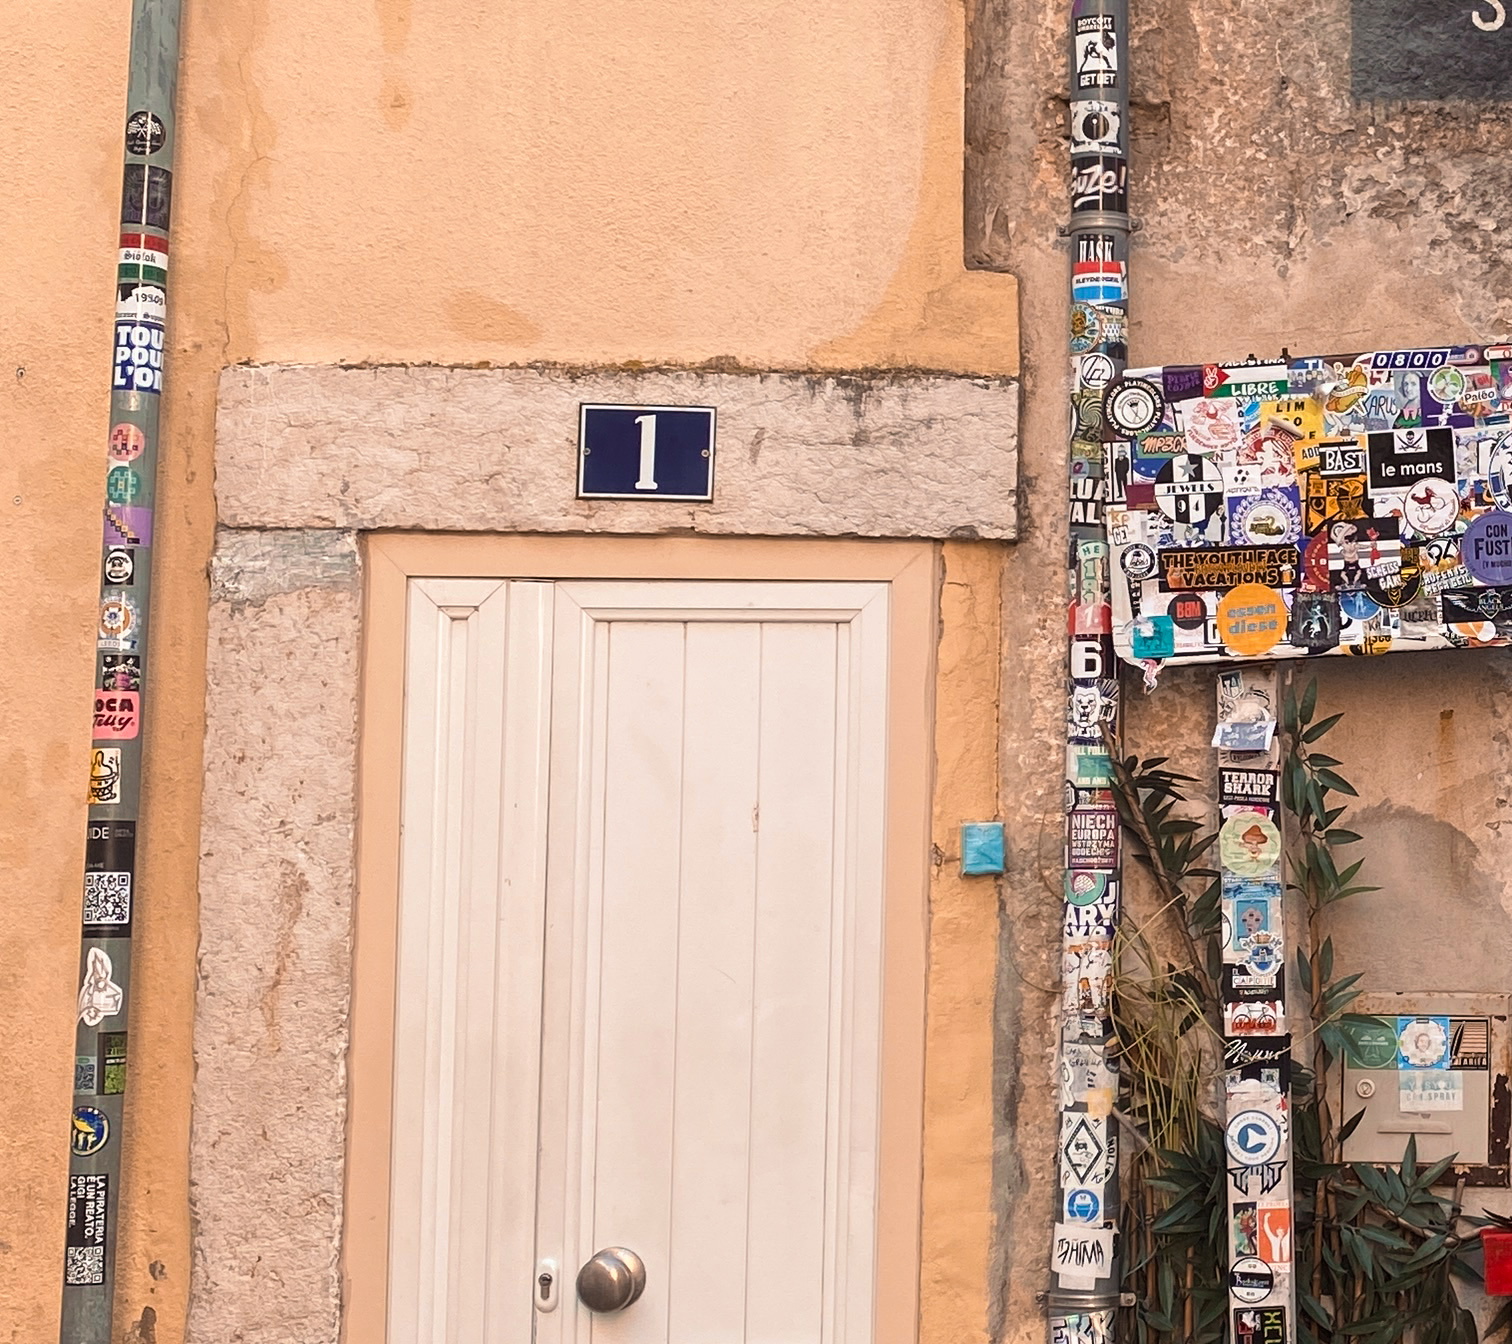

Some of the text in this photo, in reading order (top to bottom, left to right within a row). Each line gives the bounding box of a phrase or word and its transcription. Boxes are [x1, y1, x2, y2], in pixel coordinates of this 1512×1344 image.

[1077, 17, 1112, 26] BOYCOTT
[1376, 353, 1443, 367] 0800
[1231, 381, 1279, 396] LIBRE
[634, 414, 658, 490] 1
[1381, 462, 1443, 477] le mans
[1164, 483, 1214, 494] JEWELS
[1485, 525, 1508, 538] CON
[1163, 553, 1196, 571] THE
[1195, 550, 1256, 569] YOUTH
[1256, 548, 1298, 566] FACE
[1183, 569, 1279, 587] VACATIONS
[1222, 771, 1274, 785] TERROR
[1224, 782, 1271, 796] SHARK
[1072, 814, 1115, 829] NIECH
[1072, 829, 1115, 840] EUROPA
[76, 1176, 86, 1198] GIGI
[86, 1185, 96, 1199] UN
[94, 1176, 106, 1244] LA PIRATERIA
